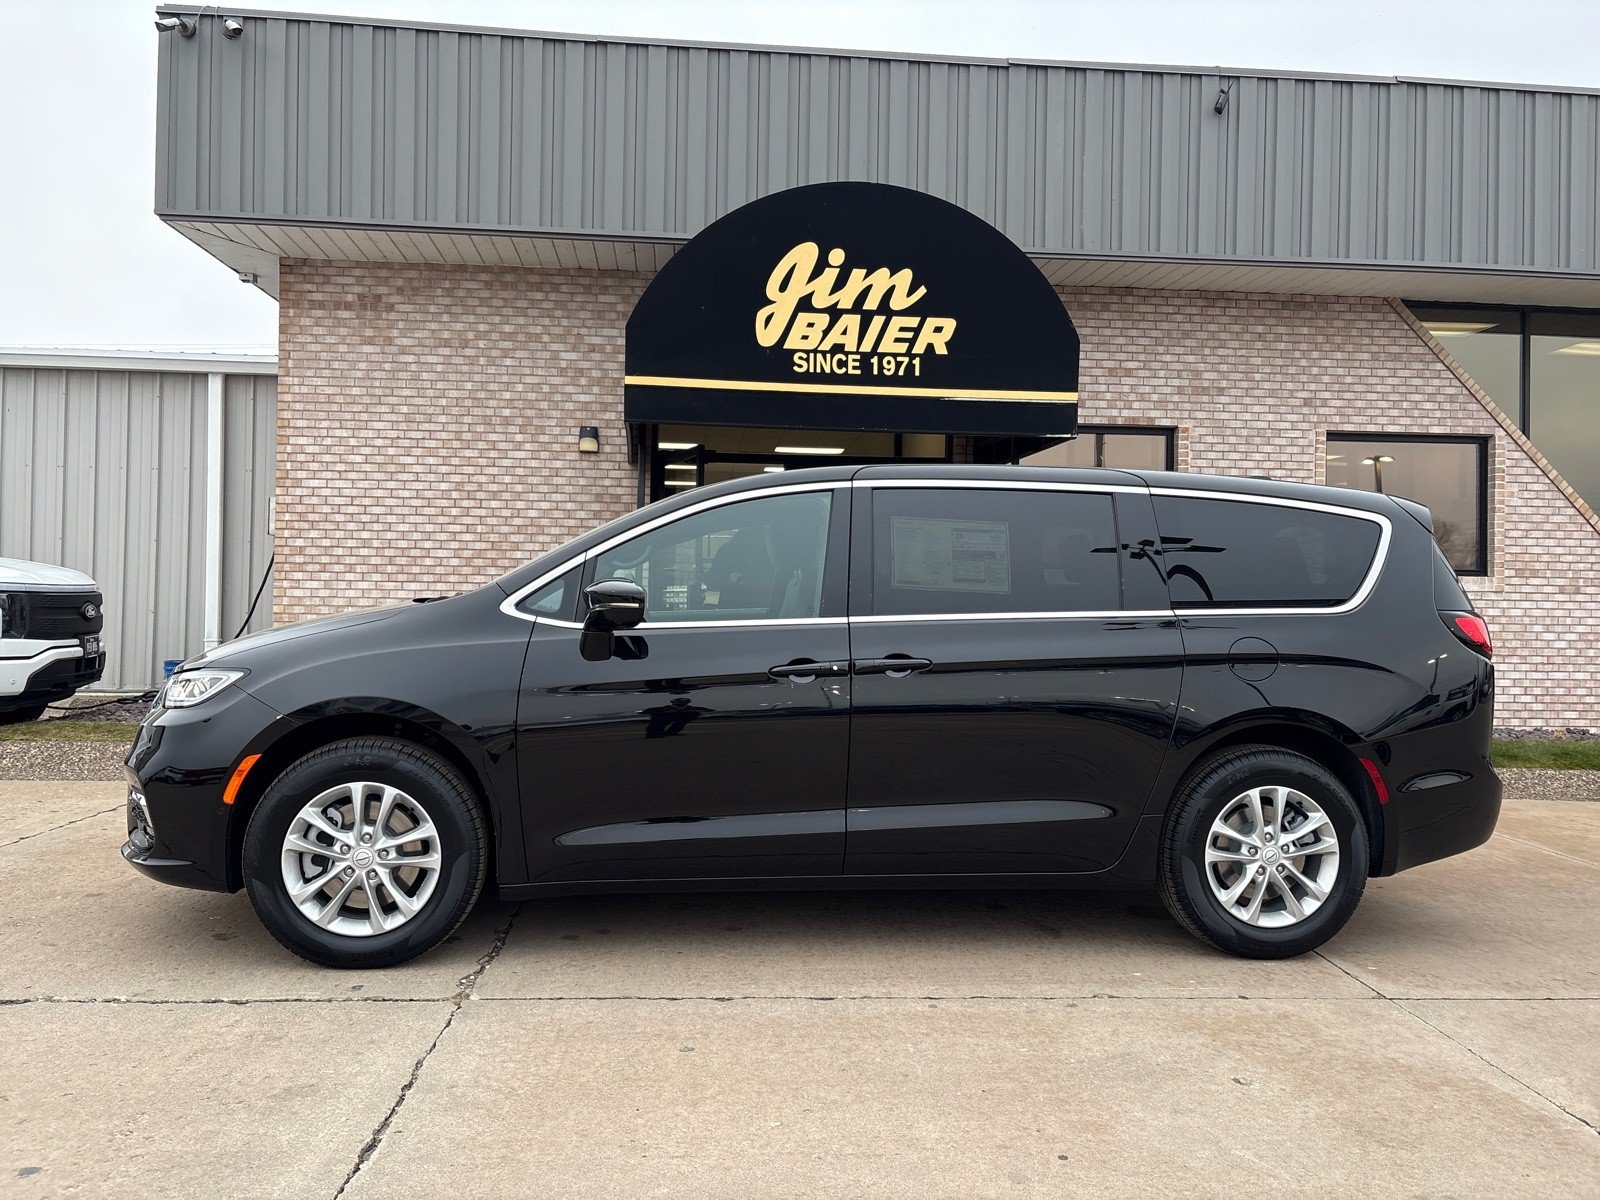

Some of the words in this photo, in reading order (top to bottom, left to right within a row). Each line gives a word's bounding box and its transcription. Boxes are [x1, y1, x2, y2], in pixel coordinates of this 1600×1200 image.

[755, 241, 927, 348] Jim
[783, 312, 957, 355] BAIER
[793, 351, 862, 375] SINCE
[870, 355, 921, 377] 1971
